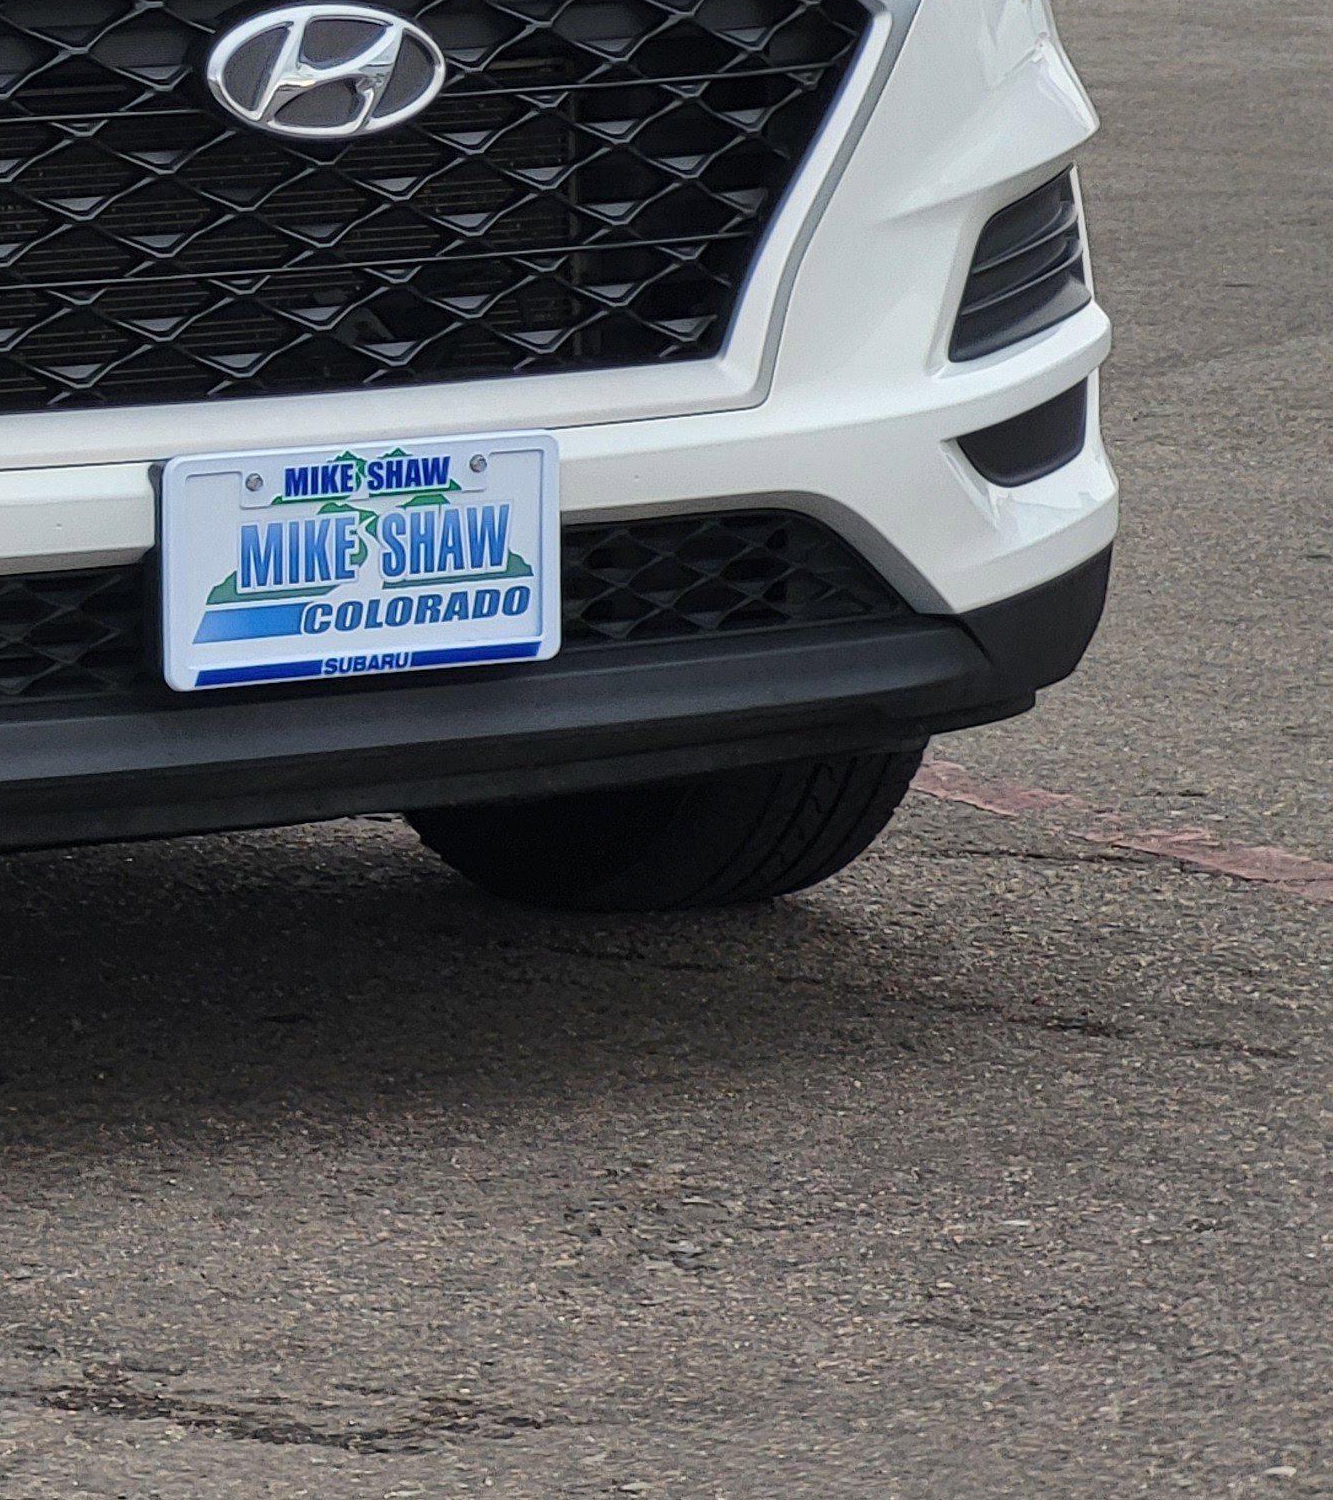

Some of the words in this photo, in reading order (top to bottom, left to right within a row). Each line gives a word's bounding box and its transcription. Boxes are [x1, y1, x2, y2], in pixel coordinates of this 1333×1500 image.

[284, 463, 353, 498] MIKE
[367, 455, 450, 491] SHAW
[241, 516, 356, 588] MIKE
[381, 504, 510, 578] SHAW
[302, 585, 531, 635] COLORADO
[323, 652, 410, 675] SUBARU
